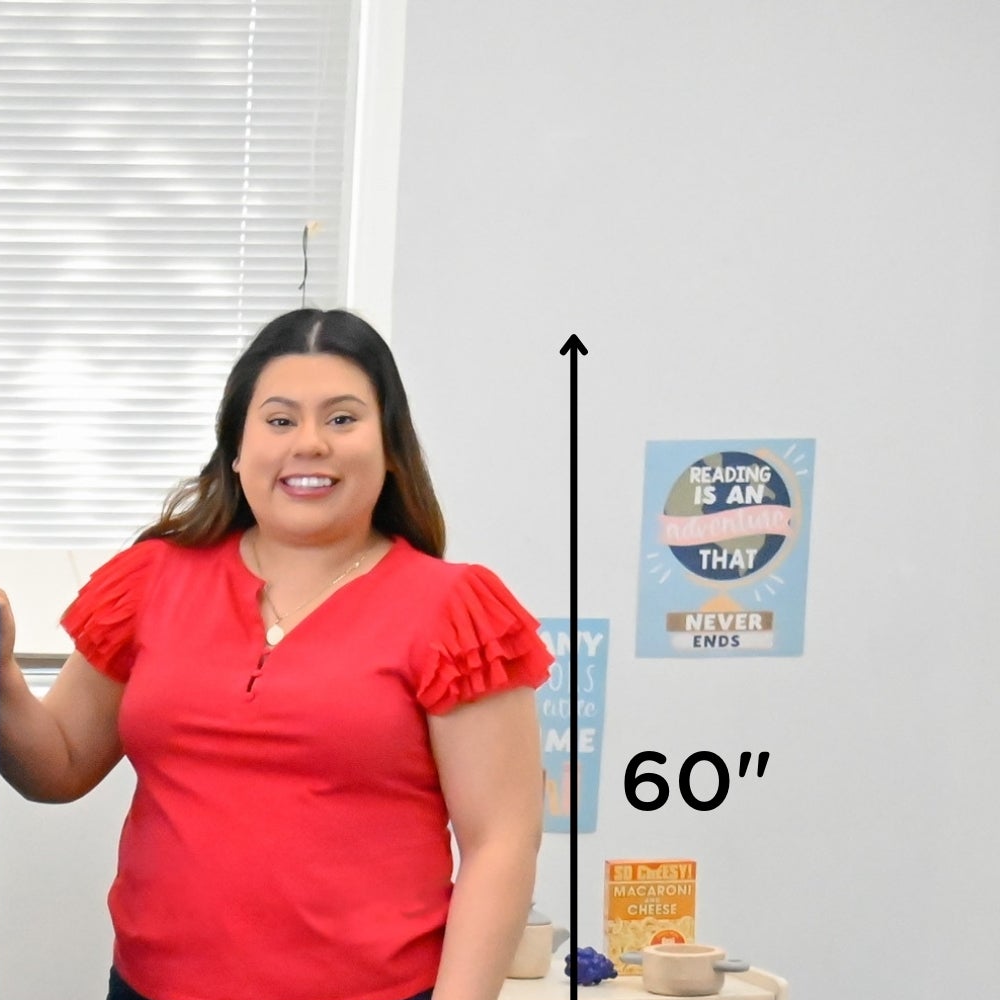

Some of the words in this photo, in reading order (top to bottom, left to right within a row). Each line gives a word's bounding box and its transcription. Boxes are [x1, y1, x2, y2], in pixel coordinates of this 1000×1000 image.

[690, 466, 771, 483] READING
[694, 485, 717, 505] IS
[726, 484, 764, 504] AN
[699, 549, 758, 570] THAT
[685, 613, 762, 631] NEVER
[539, 631, 604, 657] ANY
[693, 634, 740, 648] ENDS
[544, 728, 596, 753] ME
[613, 884, 692, 897] MACARONI
[627, 903, 677, 915] CHEESE
